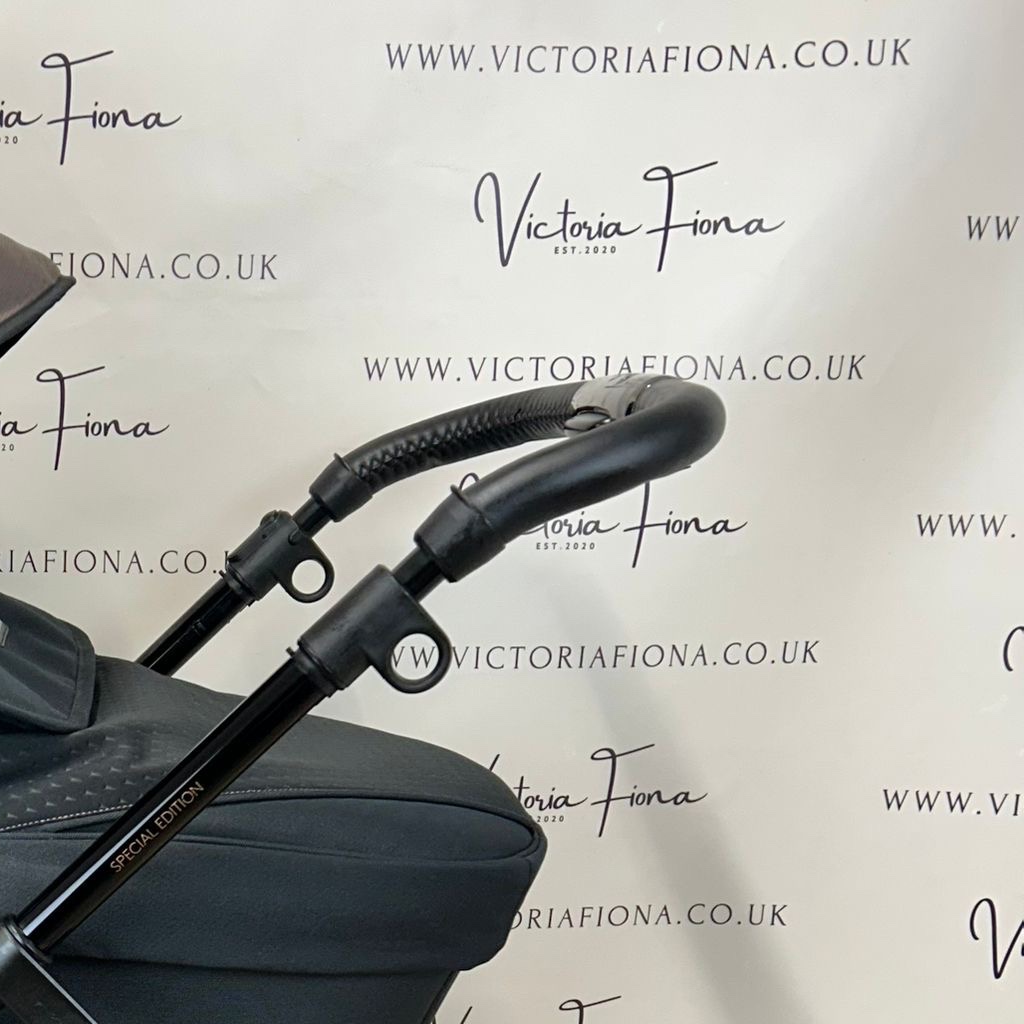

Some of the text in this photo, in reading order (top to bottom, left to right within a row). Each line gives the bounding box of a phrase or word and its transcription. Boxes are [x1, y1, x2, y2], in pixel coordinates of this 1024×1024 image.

[385, 39, 913, 74] WWW.VICTORIAFIONA.CO.UK
[40, 50, 182, 166] Fiona
[474, 161, 786, 273] Victoria Fiona
[363, 353, 866, 383] WWW.VICTORIAFIONA.CO.UK
[36, 366, 170, 471] Fiona
[110, 781, 205, 873] SPECIAL EDITION
[590, 743, 708, 838] Fiona
